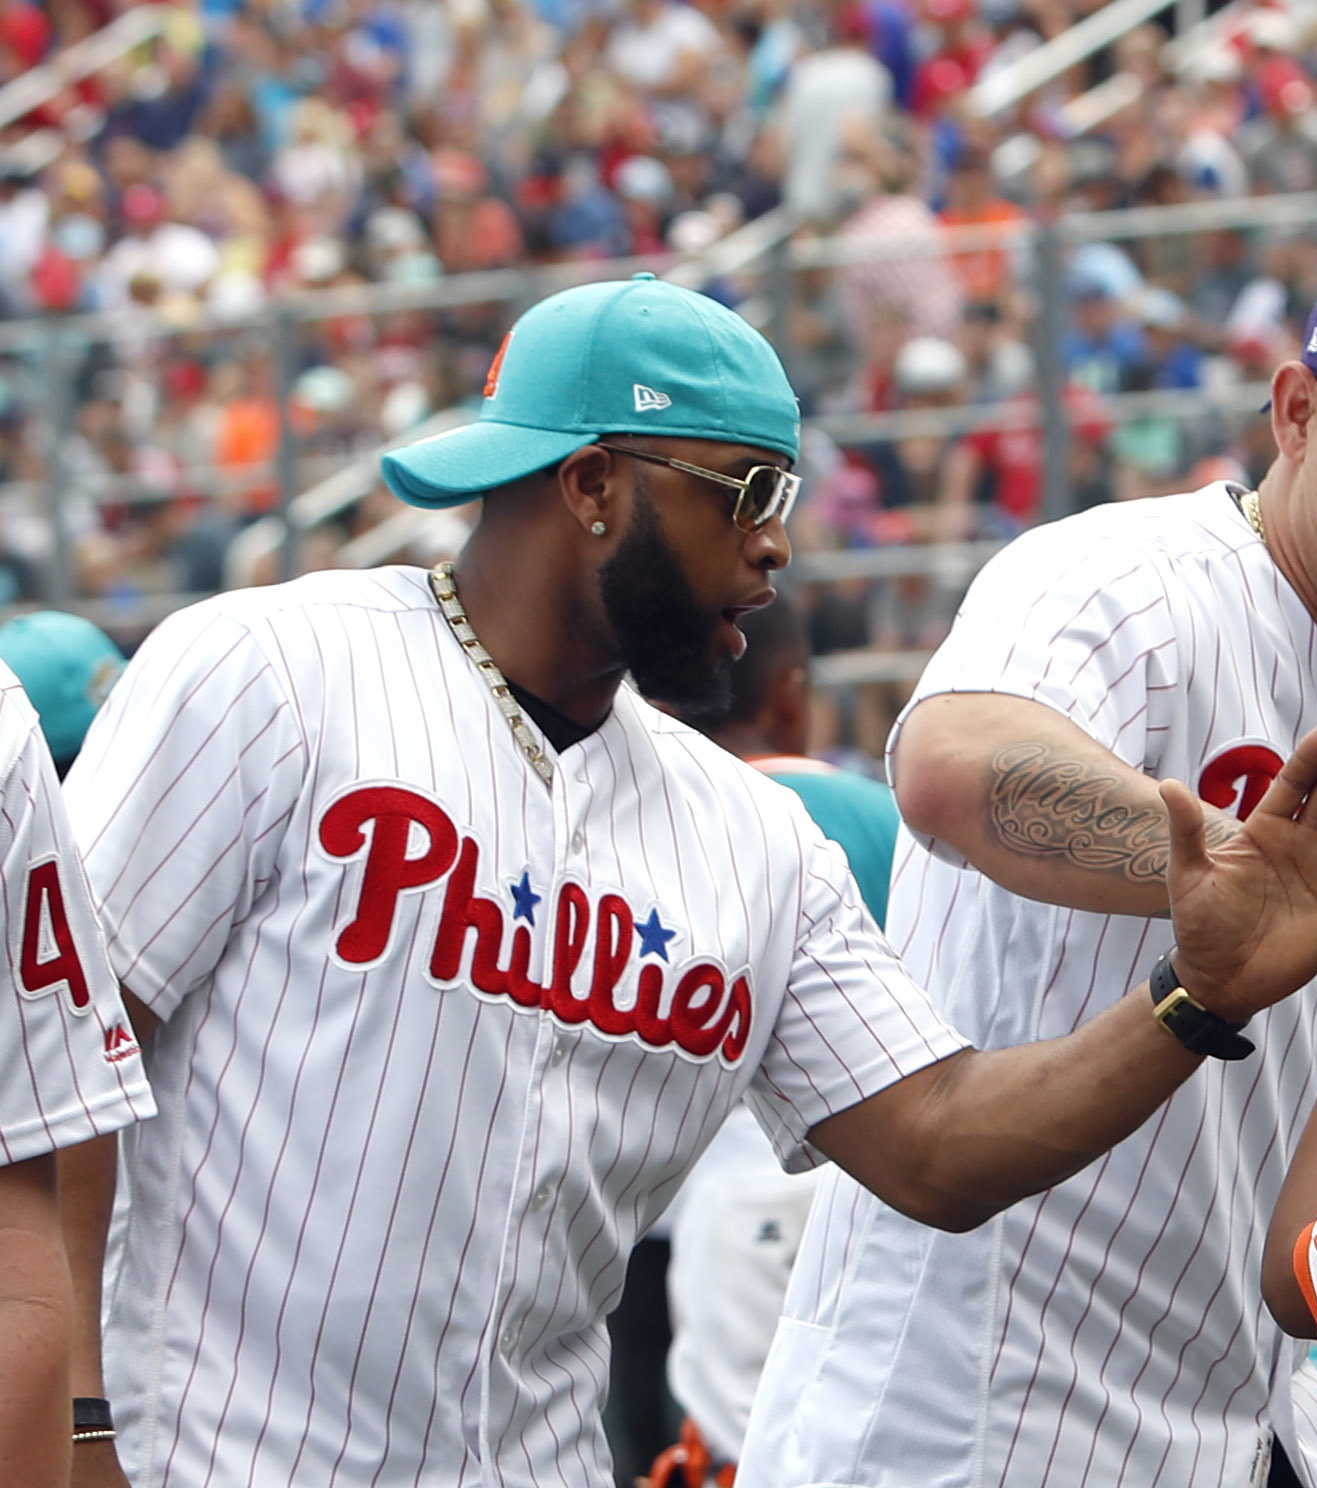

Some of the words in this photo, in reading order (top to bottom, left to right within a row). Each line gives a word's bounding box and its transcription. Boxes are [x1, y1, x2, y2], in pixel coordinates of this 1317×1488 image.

[993, 743, 1168, 850] Wilson
[18, 858, 93, 1010] 4
[316, 784, 757, 1066] Phillies
